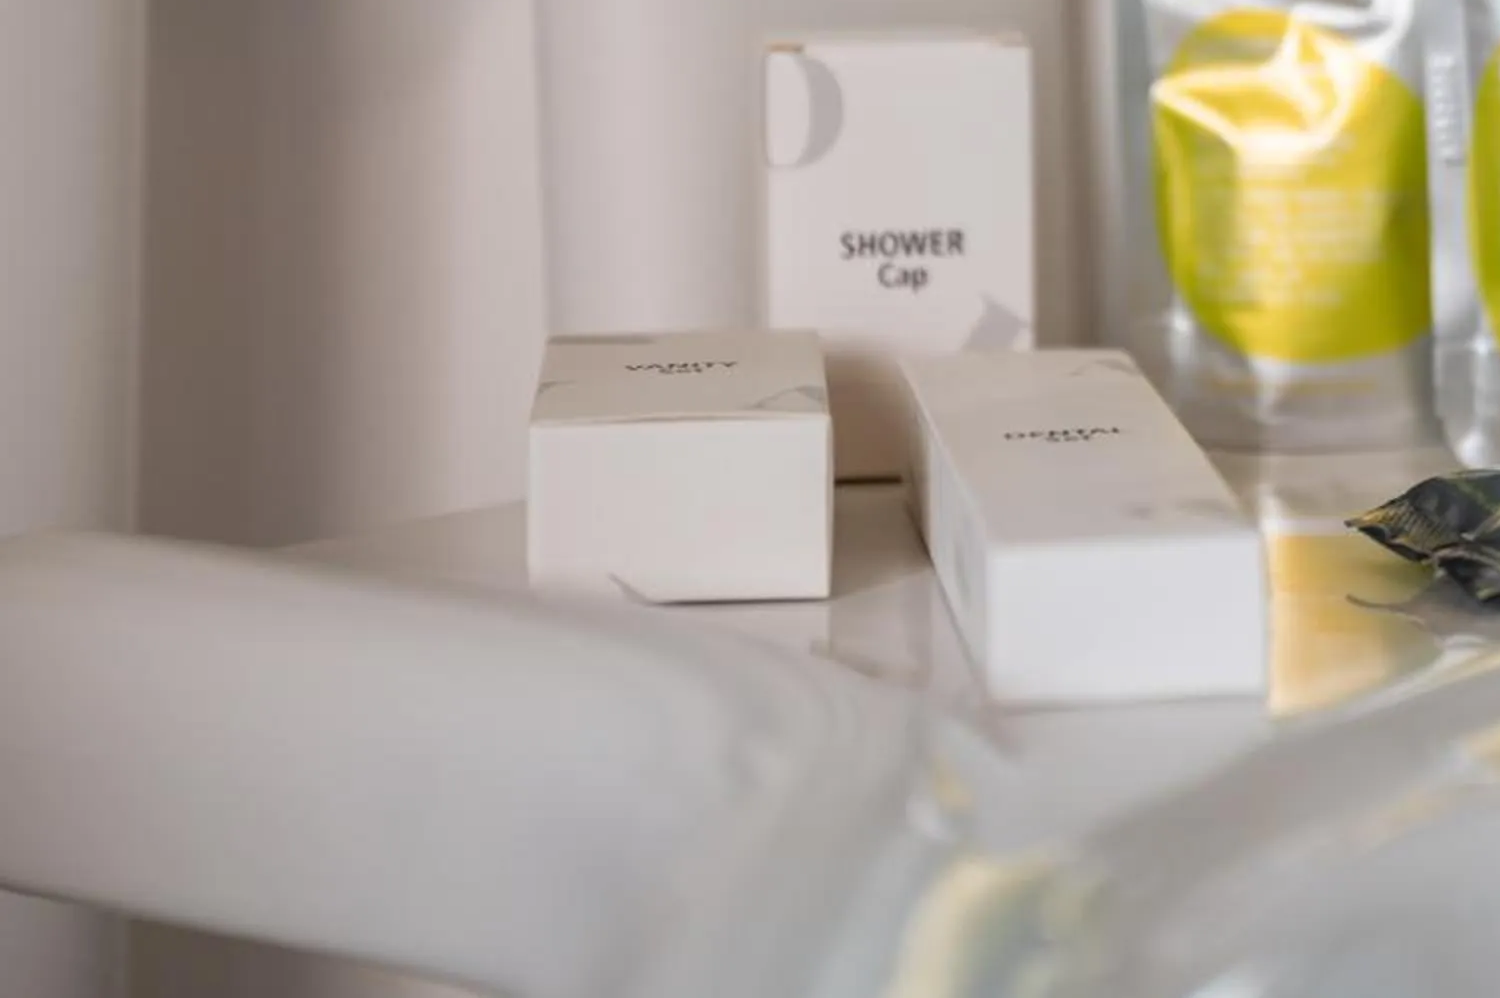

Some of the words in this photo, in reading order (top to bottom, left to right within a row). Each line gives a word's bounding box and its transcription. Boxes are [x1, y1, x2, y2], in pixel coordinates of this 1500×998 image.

[838, 229, 966, 260] SHOWER
[876, 262, 929, 295] Cap
[624, 360, 739, 372] VANITY
[1002, 427, 1121, 442] DENTAL
